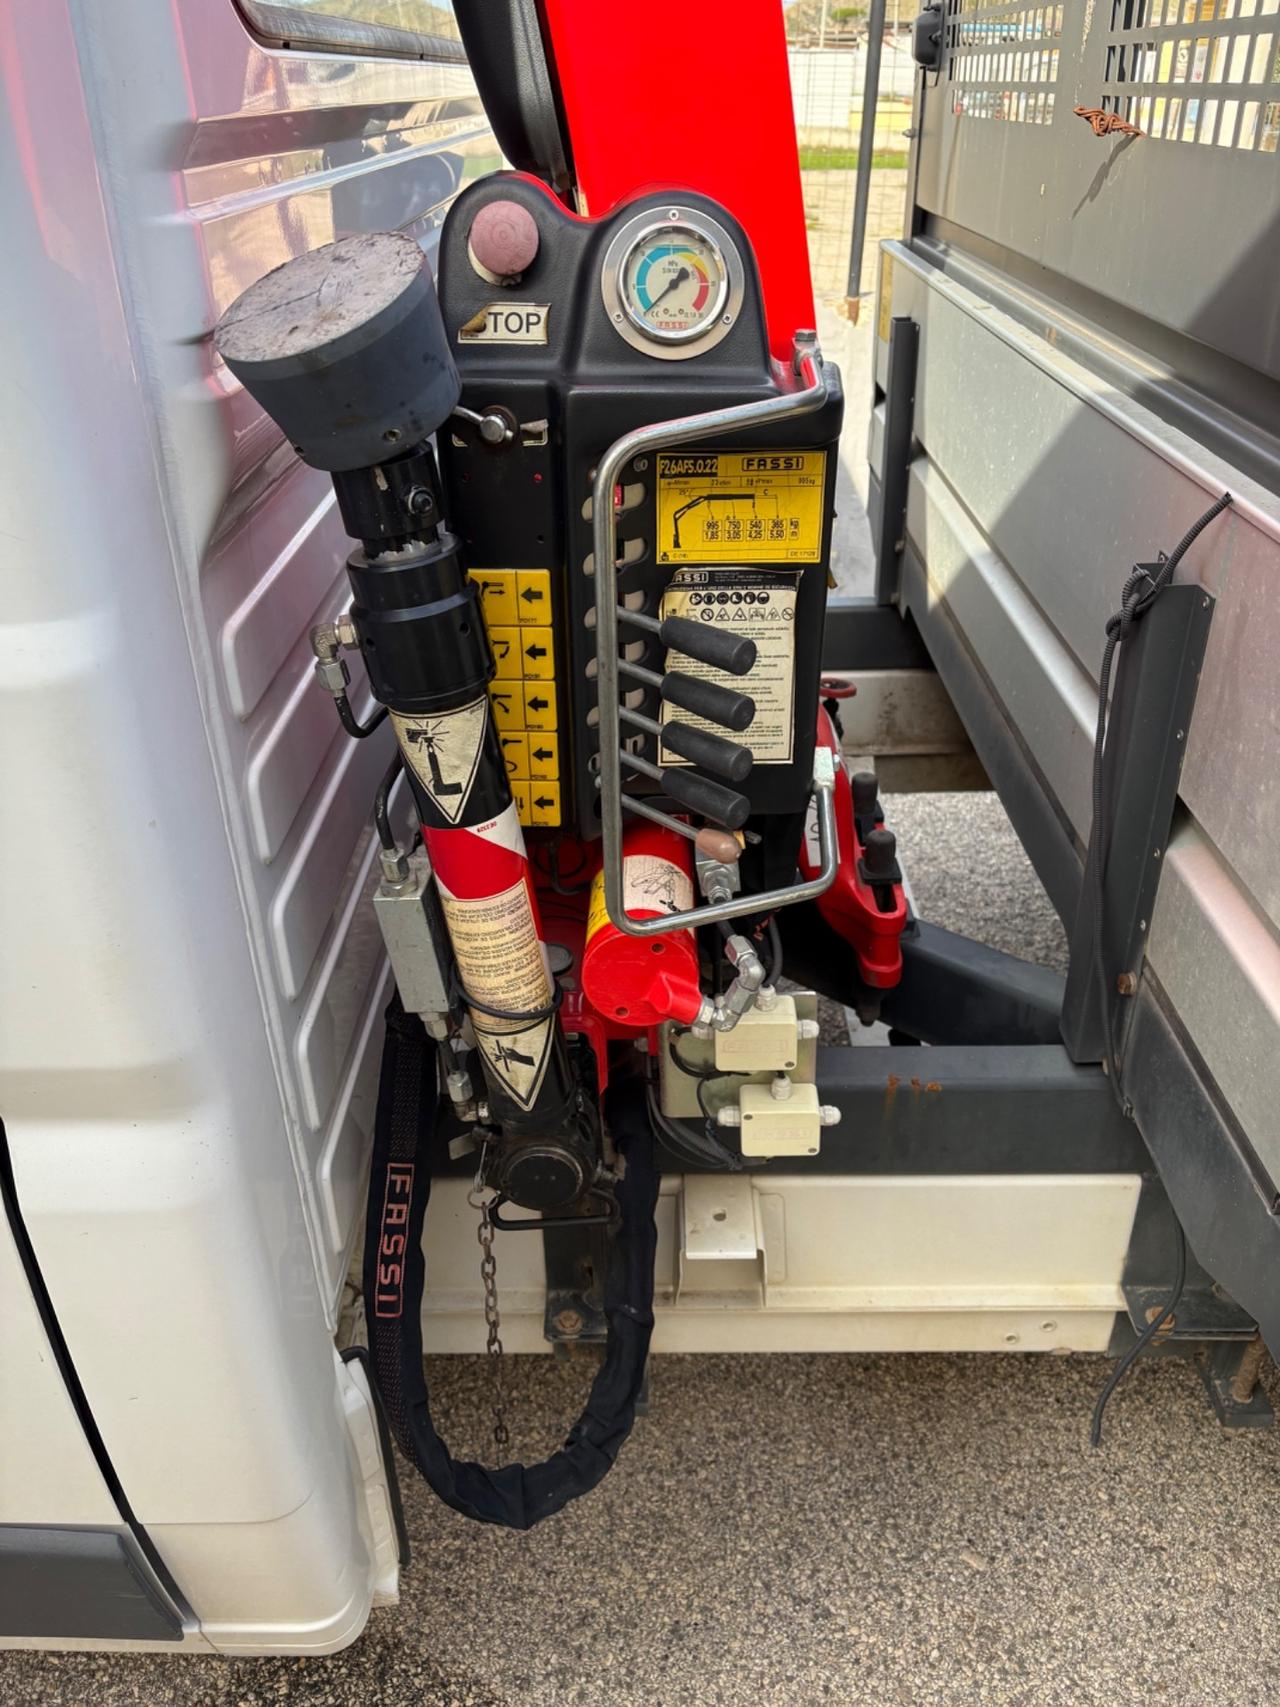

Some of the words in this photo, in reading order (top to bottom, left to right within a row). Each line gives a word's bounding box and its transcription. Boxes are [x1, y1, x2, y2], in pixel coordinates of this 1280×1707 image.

[487, 311, 541, 333] TOP
[659, 459, 717, 475] F26AFS.0.22
[745, 457, 801, 470] FASSI
[728, 520, 741, 529] 750
[750, 520, 762, 529] 540
[790, 519, 799, 529] kg
[674, 573, 705, 583] ASSI
[378, 1173, 411, 1302] FASSI
